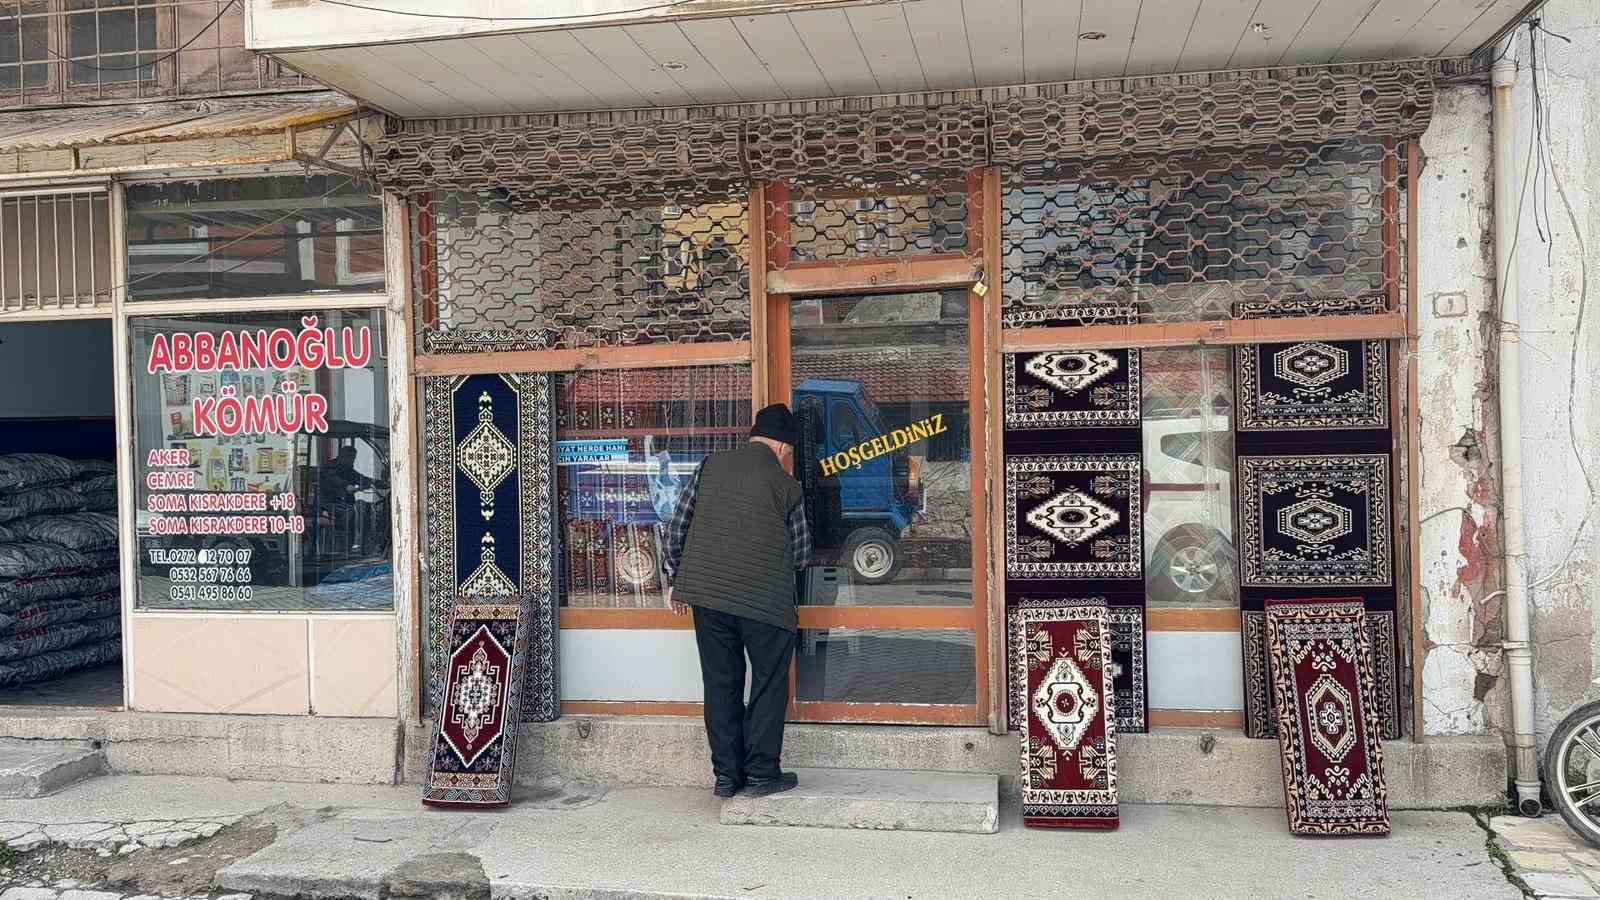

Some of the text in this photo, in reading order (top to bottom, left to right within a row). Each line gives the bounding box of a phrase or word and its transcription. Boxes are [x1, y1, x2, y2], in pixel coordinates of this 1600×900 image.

[148, 315, 371, 374] ABBANOĞLU
[193, 381, 329, 436] KÖMÜR
[147, 449, 190, 467] AKER
[147, 471, 195, 489] CEMRE
[148, 492, 296, 511] SOMA KISRAKDERE +18
[149, 515, 305, 535] SOMA KISRAKDERE 10-18
[149, 549, 252, 564] TEL.0272 12 70 07
[170, 567, 252, 582] 0532 567 76 66
[171, 585, 252, 600] 0541 495 86 60
